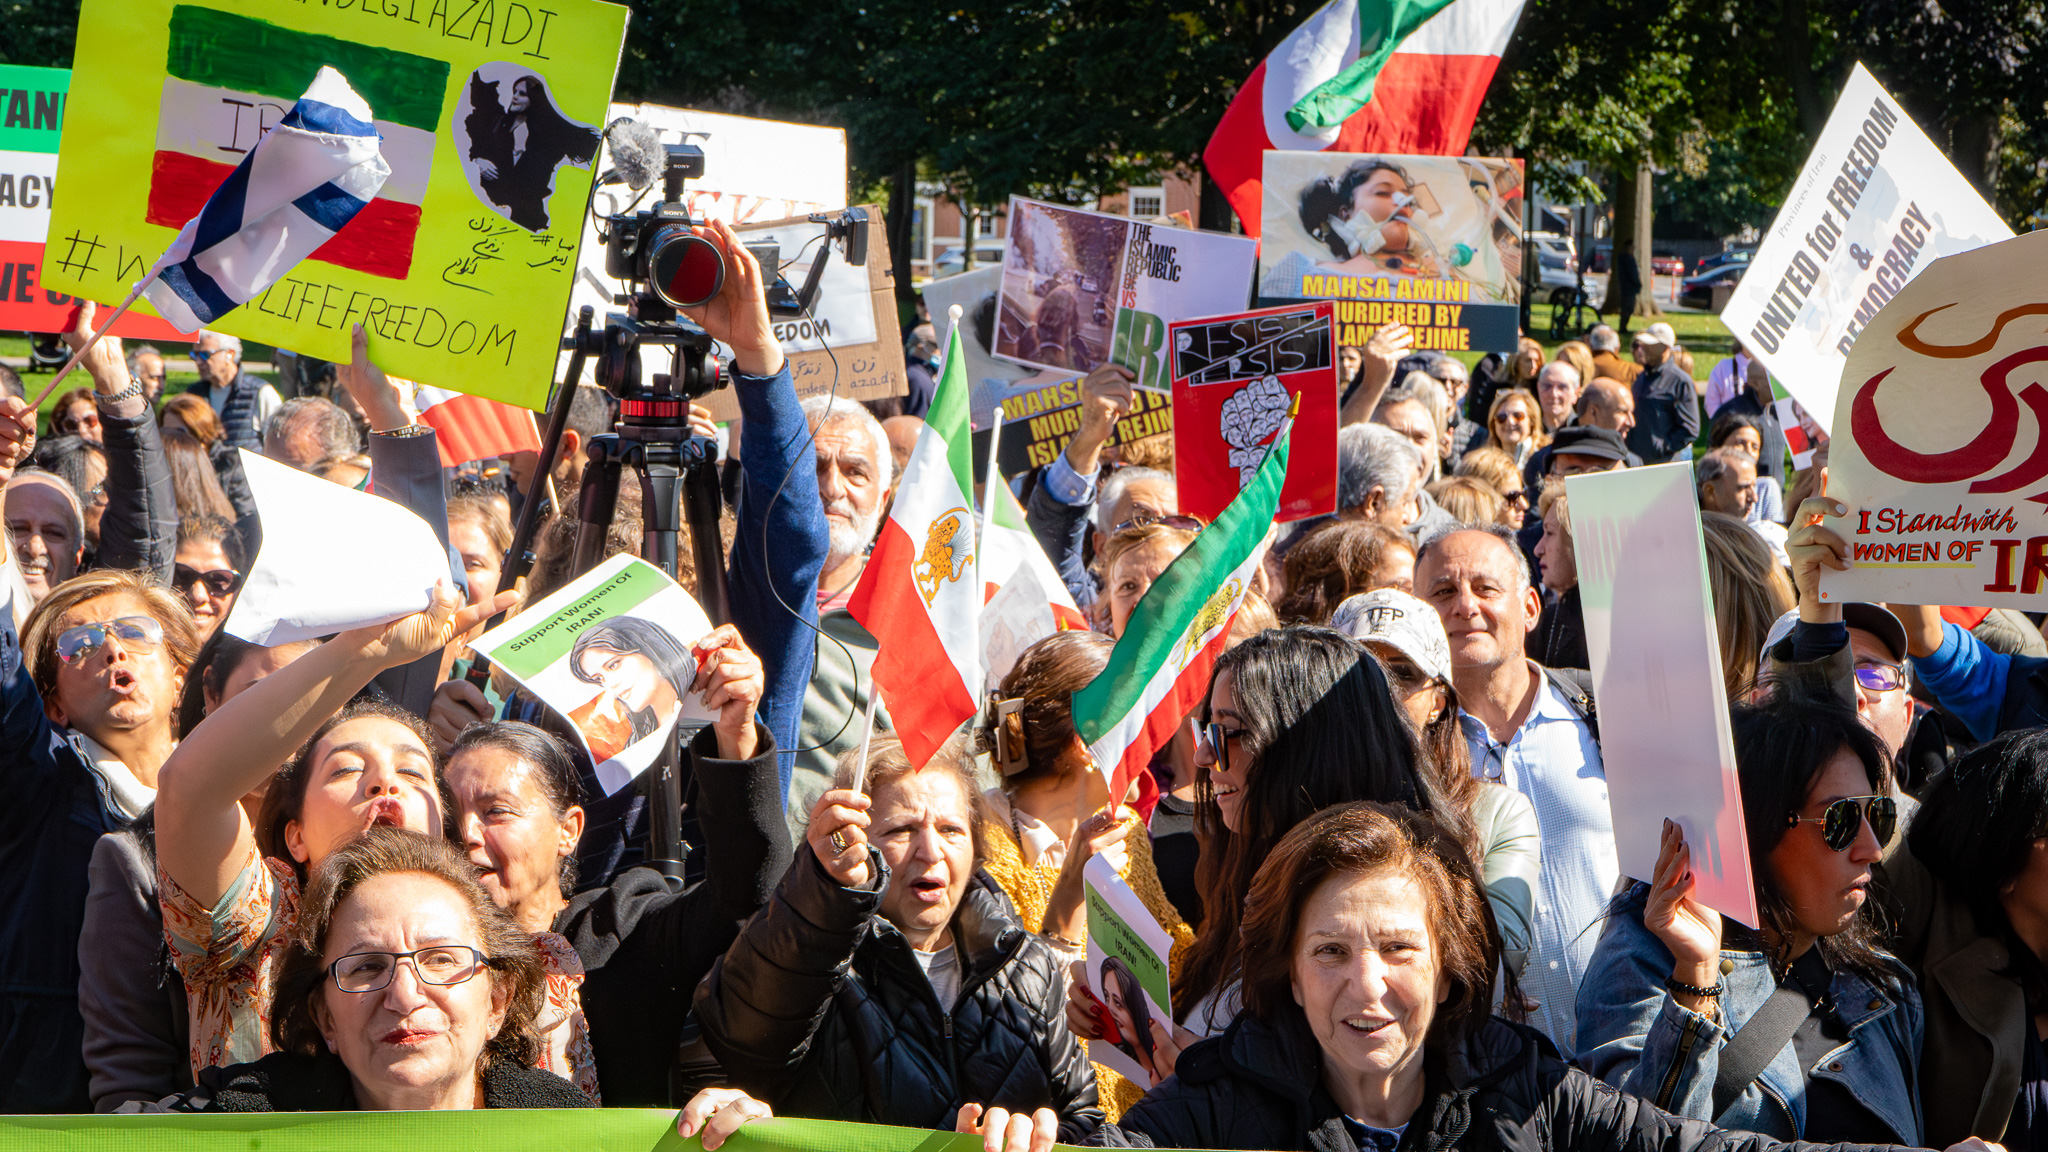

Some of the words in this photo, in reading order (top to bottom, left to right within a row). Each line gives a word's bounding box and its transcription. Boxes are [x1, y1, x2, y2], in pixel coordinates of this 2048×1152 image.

[1777, 186, 1808, 238] Provinces
[1806, 171, 1816, 188] of
[1812, 153, 1827, 178] Iran
[1132, 222, 1153, 242] THE
[1751, 250, 1820, 355] UNITED
[1805, 210, 1842, 262] for
[1826, 96, 1898, 221] FREEDOM
[1129, 239, 1177, 264] ISLAMIC
[1849, 243, 1874, 270] &
[1126, 256, 1182, 282] REPUBLIC
[1122, 289, 1137, 309] VS
[1302, 274, 1391, 298] MAHSA
[1395, 278, 1470, 302] AMINI
[1435, 304, 1462, 327] BY
[1856, 510, 1871, 535] I
[1853, 541, 1941, 563] WOMEN
[1947, 541, 1984, 562] OF
[510, 616, 567, 652] Support
[564, 583, 617, 618] Women
[614, 571, 633, 586] Of
[566, 607, 605, 634] IRAN!
[1092, 895, 1121, 933] Support
[1115, 937, 1137, 967] IRAN!
